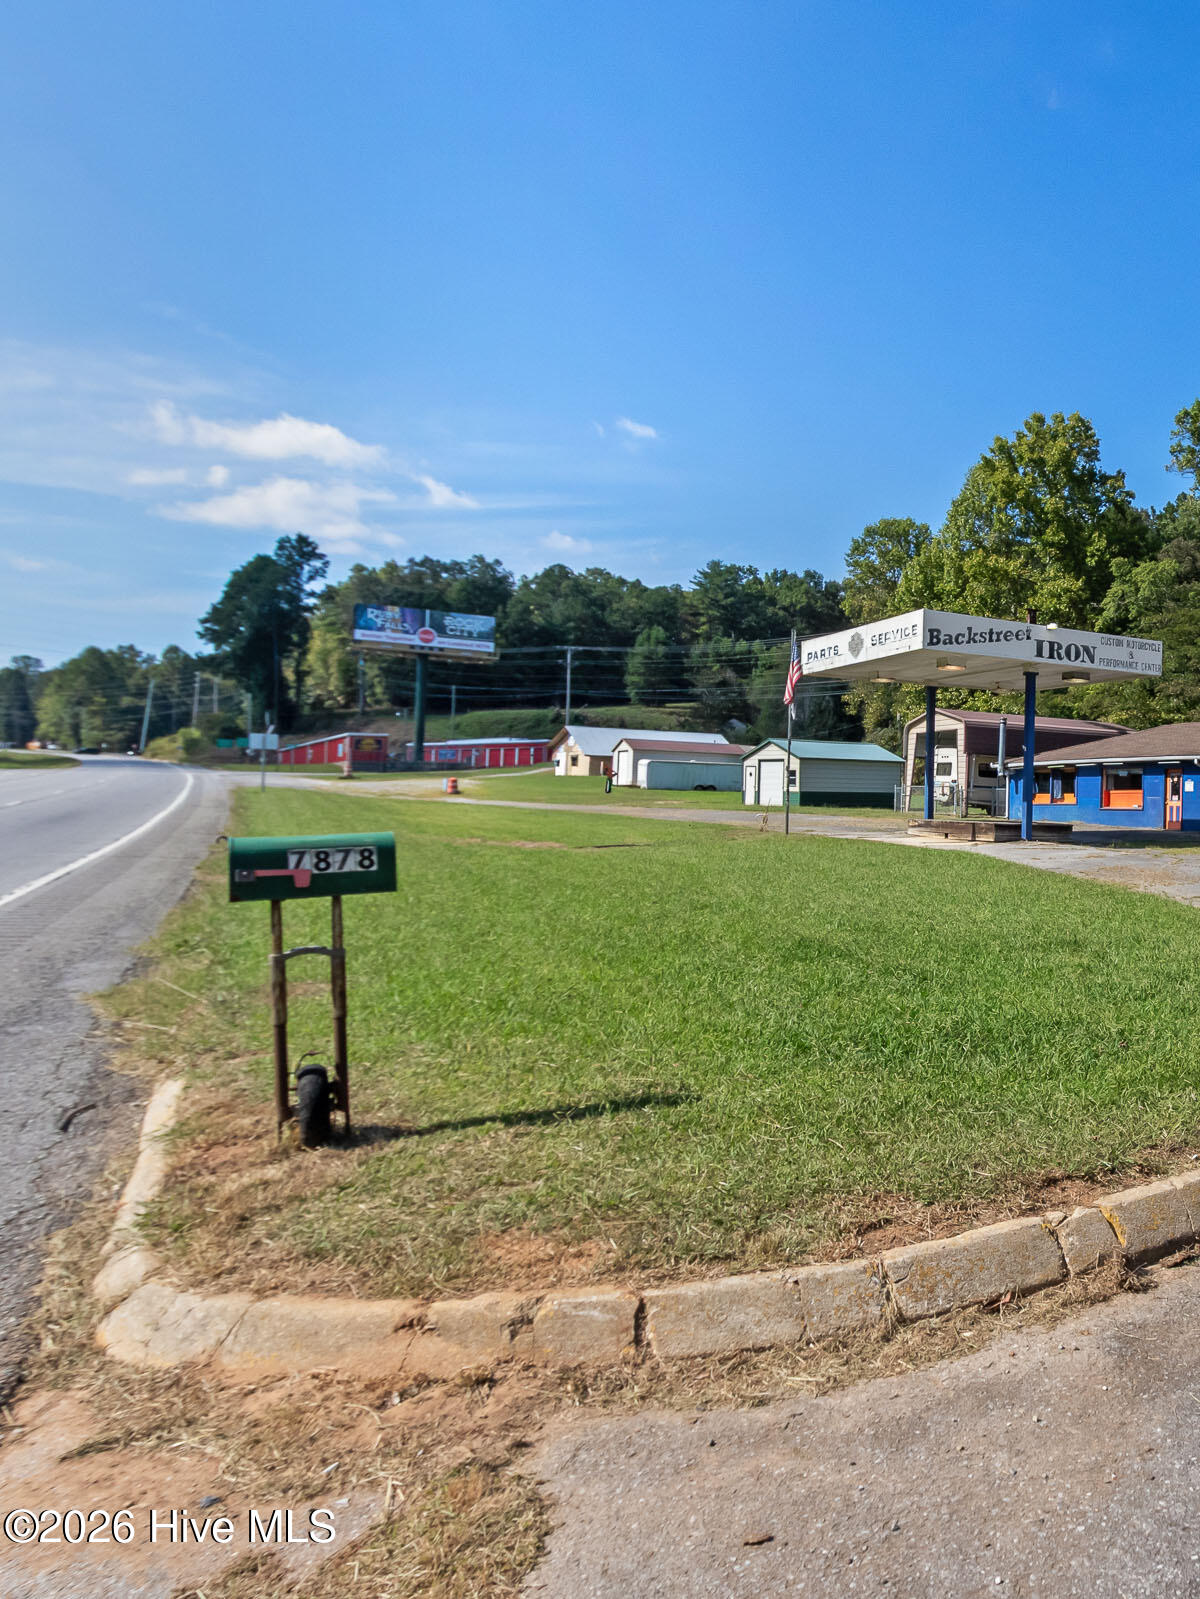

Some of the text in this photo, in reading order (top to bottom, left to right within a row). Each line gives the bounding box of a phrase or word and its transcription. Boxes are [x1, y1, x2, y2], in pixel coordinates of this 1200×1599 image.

[871, 624, 918, 647] SERVICE
[927, 626, 1032, 646] Backstreet
[1100, 636, 1161, 653] CUSTOM MOTORCYCLE
[807, 644, 839, 662] PARTS
[1034, 639, 1097, 664] IRON
[1099, 657, 1161, 673] PERFORMANCE CENTER
[291, 847, 375, 873] 7878
